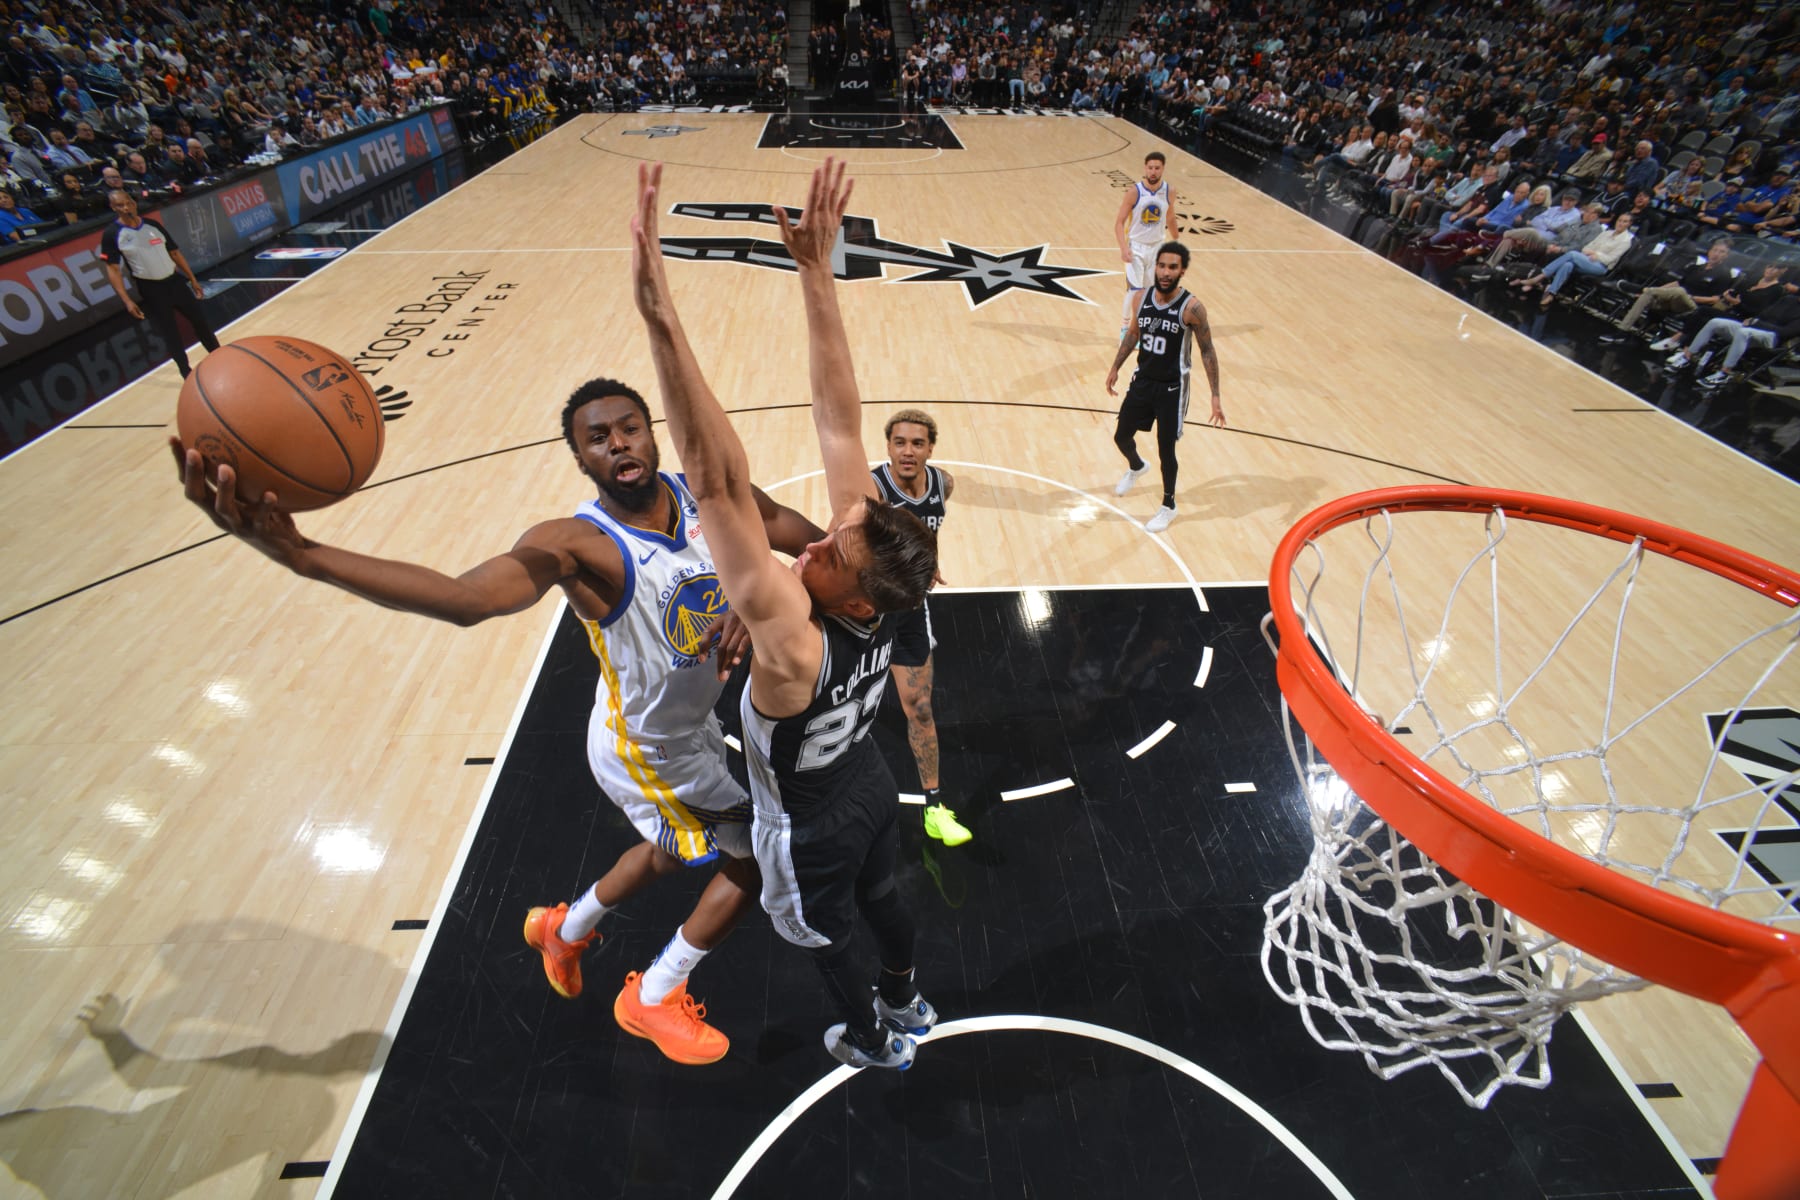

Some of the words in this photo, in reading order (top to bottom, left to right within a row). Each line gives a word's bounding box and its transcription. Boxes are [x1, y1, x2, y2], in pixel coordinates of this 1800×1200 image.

[300, 151, 366, 204] CALL
[359, 133, 406, 177] THE
[223, 185, 265, 215] DAVIS
[234, 214, 254, 232] LAW
[252, 207, 273, 225] FIRM
[0, 243, 132, 347] ORE
[394, 268, 491, 314] Bank
[426, 282, 520, 358] CENTER
[1142, 333, 1167, 355] 30
[658, 565, 695, 609] GOLDEN
[702, 585, 728, 613] 22
